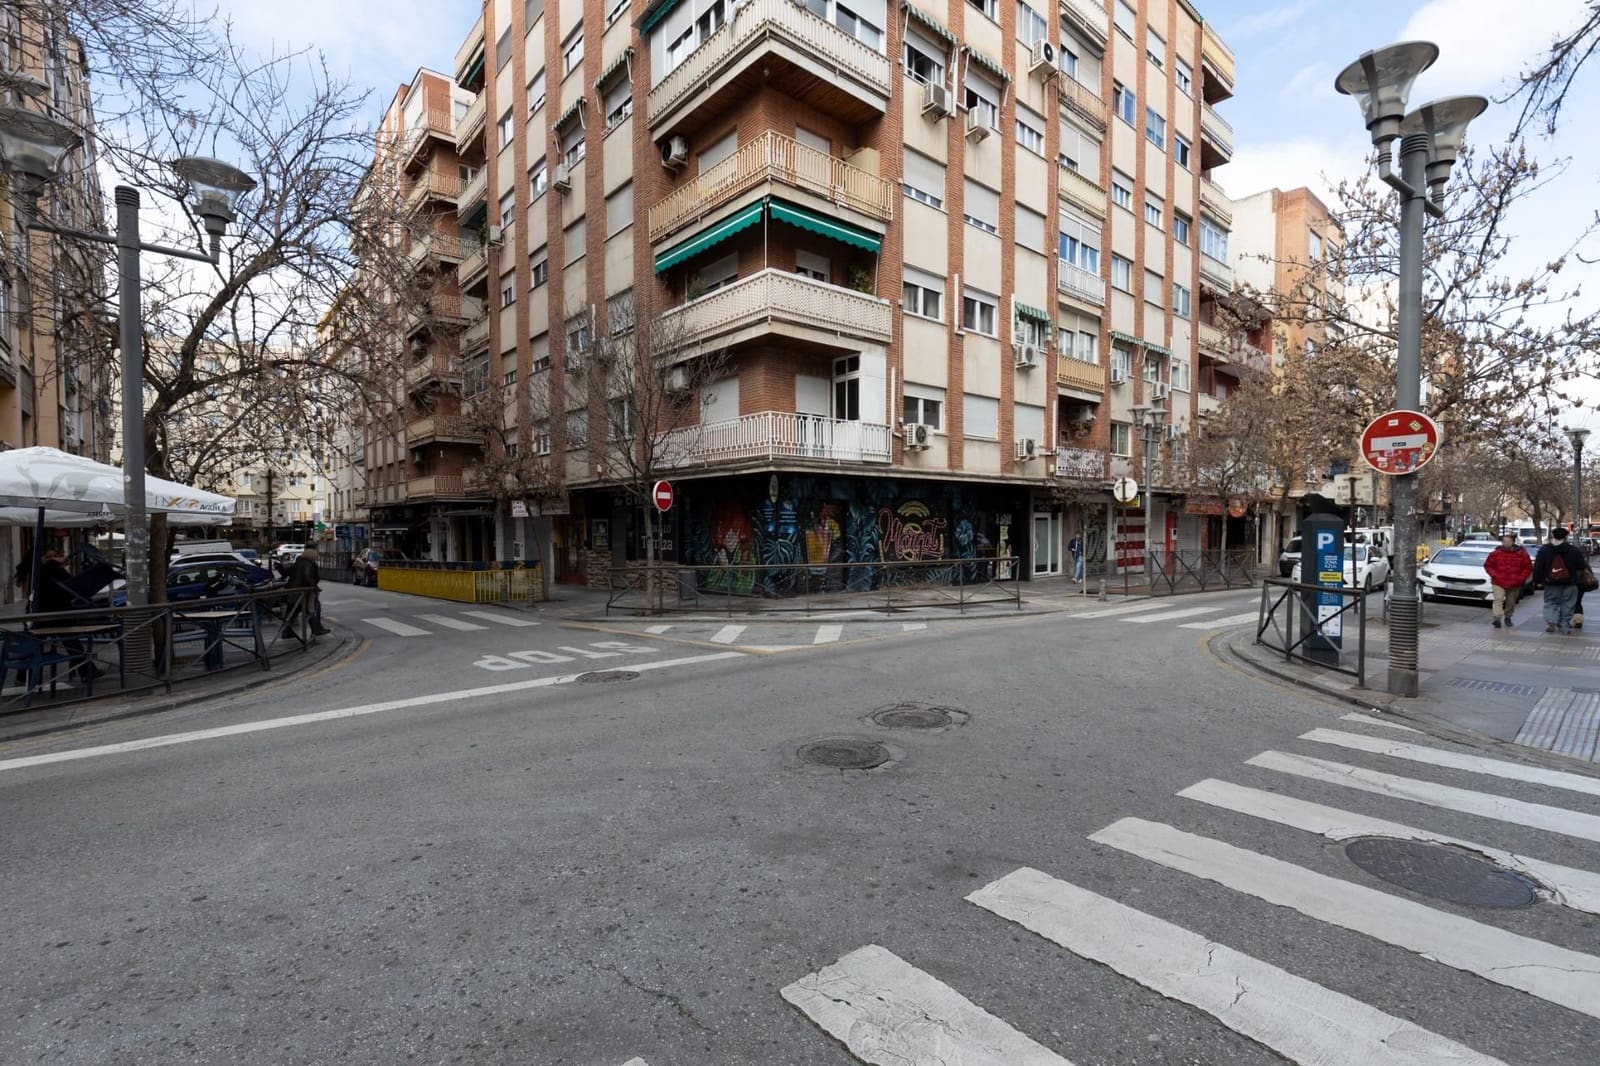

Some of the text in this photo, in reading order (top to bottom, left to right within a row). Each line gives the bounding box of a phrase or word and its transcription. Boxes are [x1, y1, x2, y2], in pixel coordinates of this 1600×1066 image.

[878, 507, 947, 561] Margot
[1317, 532, 1335, 550] P
[472, 641, 661, 672] STOP
